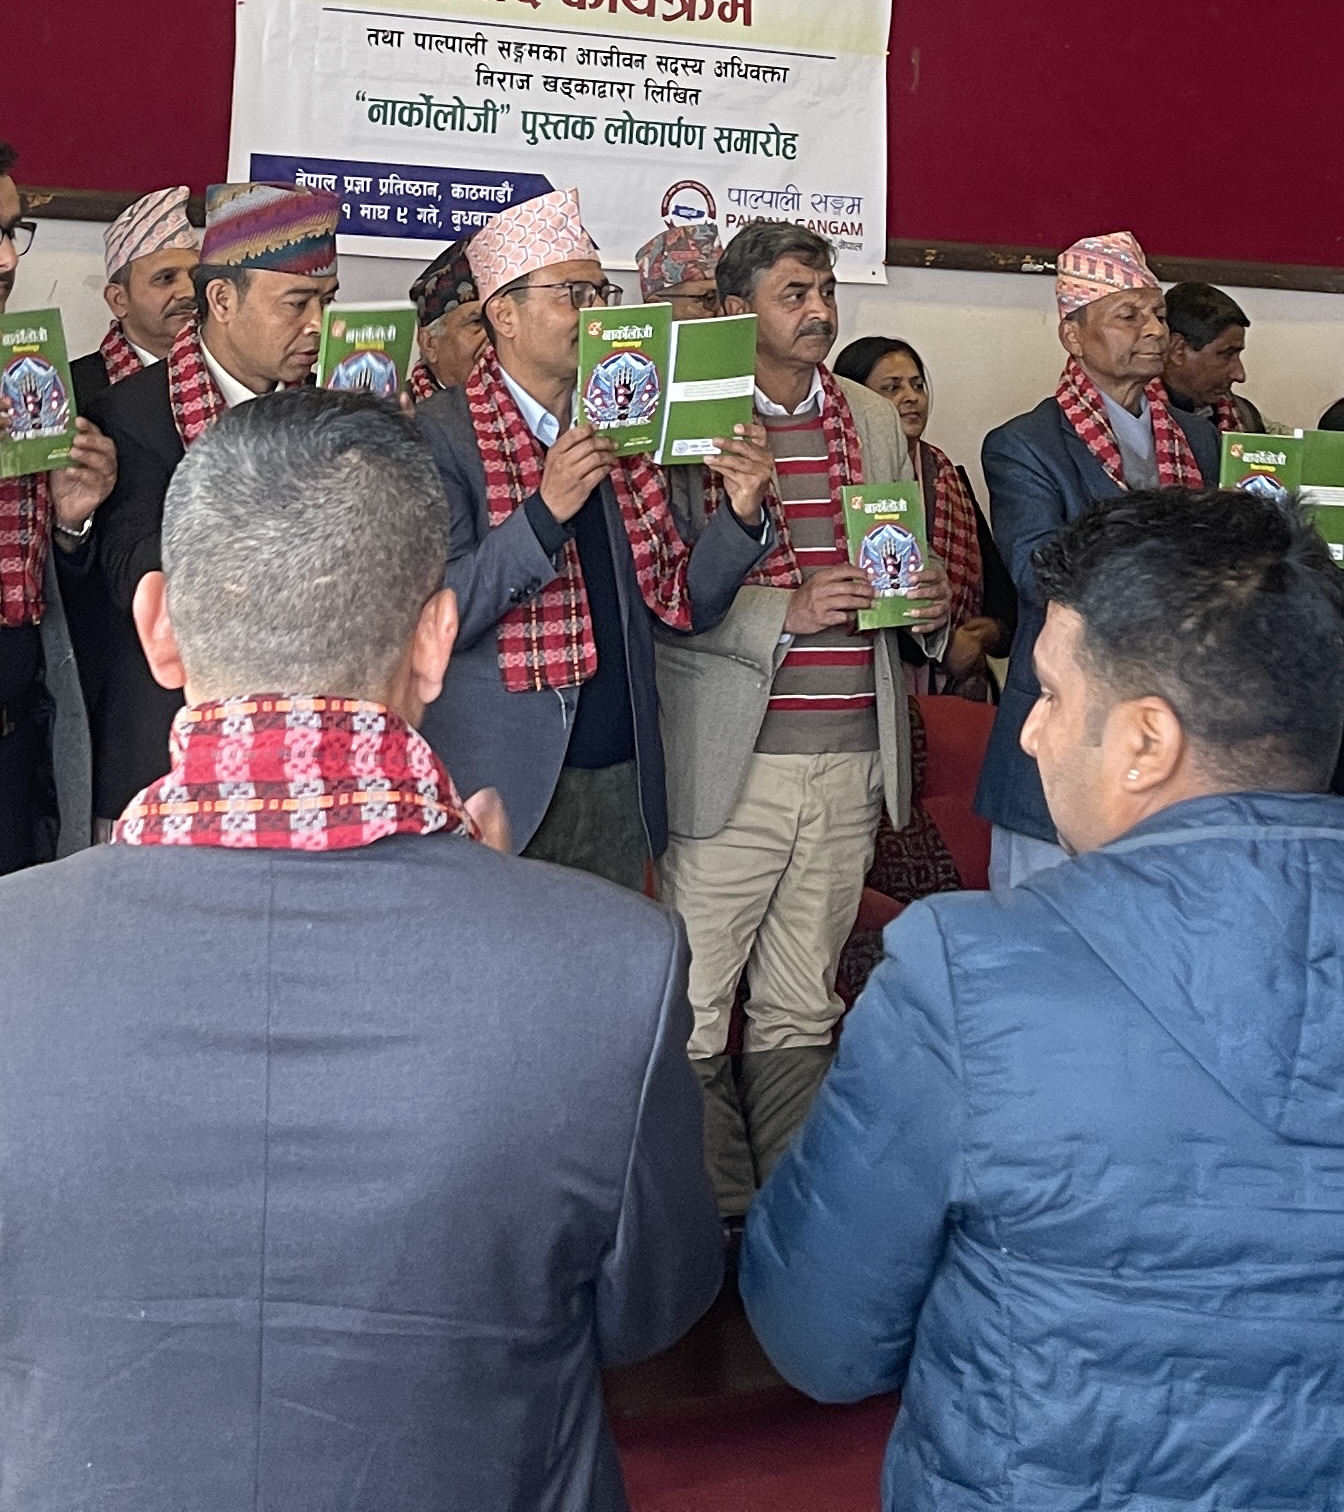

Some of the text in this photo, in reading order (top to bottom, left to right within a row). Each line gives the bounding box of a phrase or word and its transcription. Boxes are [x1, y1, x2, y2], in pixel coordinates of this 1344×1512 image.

[365, 27, 405, 49] तथा
[413, 31, 489, 57] पाल्पाली
[576, 44, 648, 71] आजीवन
[655, 54, 706, 77] सदस्य
[713, 55, 790, 84] अधिवक्ता
[474, 62, 703, 106] निराज खड्काद्वारा लिखित
[521, 109, 598, 146] पुस्तक
[605, 109, 707, 151] लोकार्पण
[713, 122, 800, 161] समारोह
[295, 168, 515, 204] नेपाल प्रज्ञा प्रतिष्ठान, काठमाडौं
[727, 183, 804, 212] पाल्पाली
[359, 203, 391, 221] माघ
[416, 204, 443, 229] गते,
[450, 209, 501, 232] बुधबा
